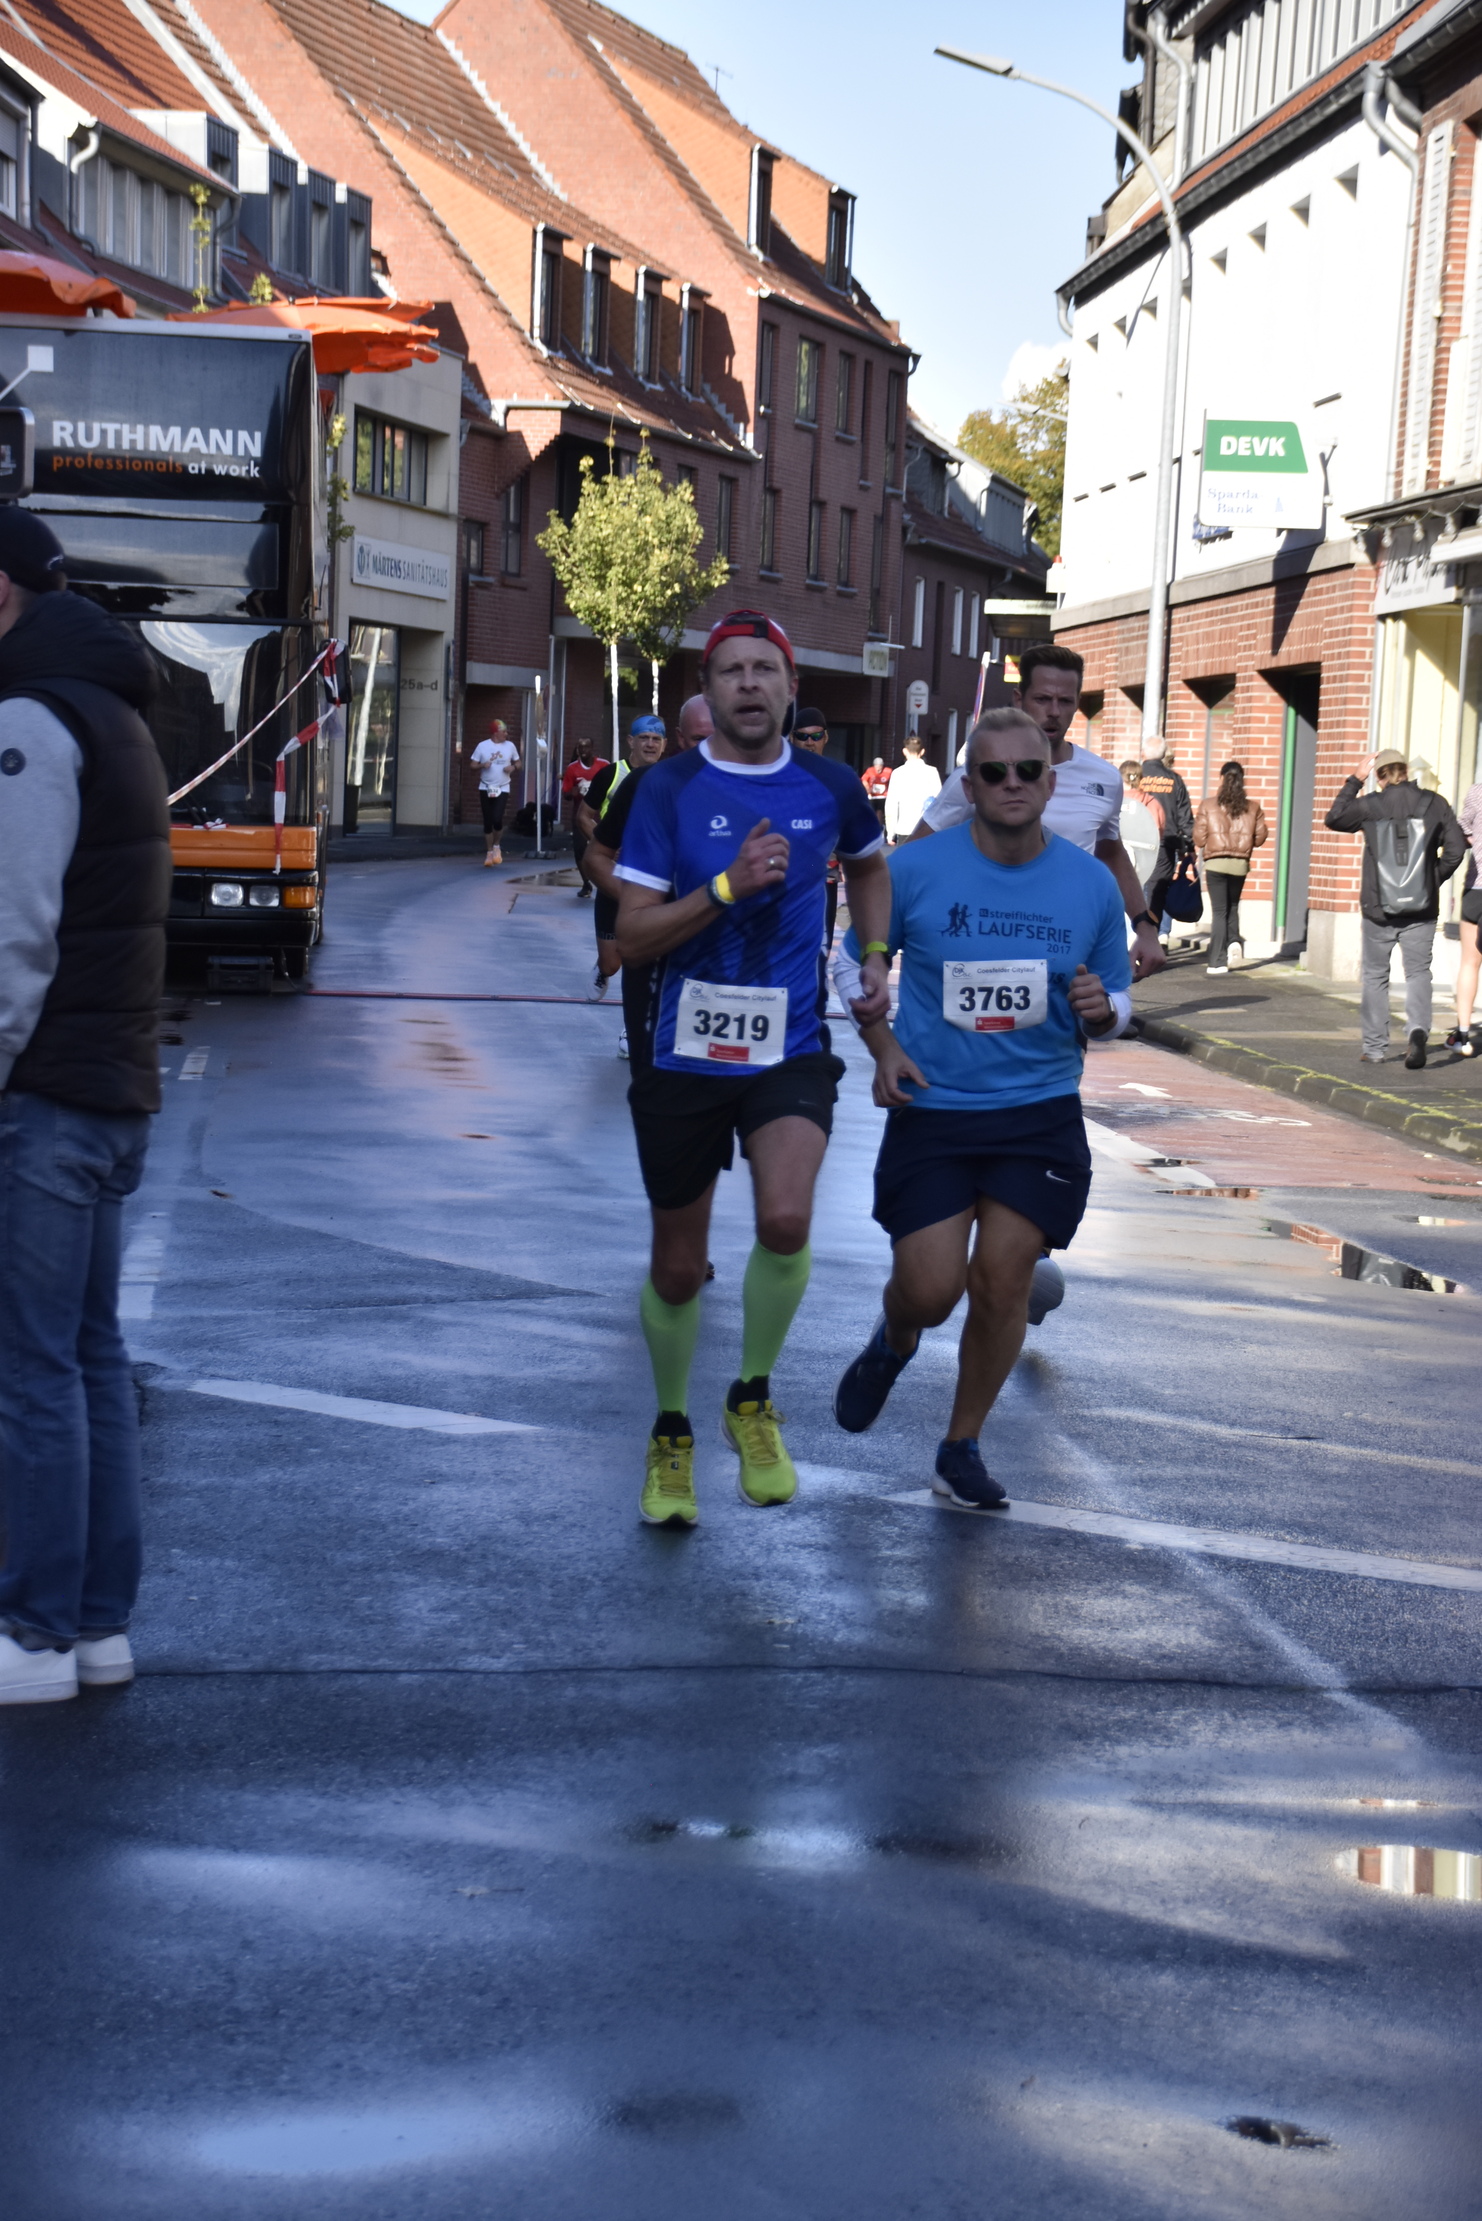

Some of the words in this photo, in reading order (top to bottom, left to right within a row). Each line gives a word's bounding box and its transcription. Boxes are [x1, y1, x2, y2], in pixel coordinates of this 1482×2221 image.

[52, 420, 262, 457] RUTHMANN
[1219, 435, 1287, 457] DEVK
[52, 453, 183, 473] professionals
[188, 461, 206, 475] at
[213, 460, 261, 478] work
[1216, 502, 1254, 514] Bank
[1140, 776, 1174, 785] piridon
[990, 910, 1053, 923] streiflichter
[978, 920, 1072, 944] LAUFSERIE
[1046, 943, 1072, 955] 2017
[976, 966, 1010, 974] Coesfelder
[1011, 965, 1036, 974] Citylauf
[714, 991, 751, 1001] Coesfelder
[751, 994, 777, 1003] Citylauf
[958, 985, 1031, 1013] 3763
[693, 1009, 770, 1042] 3219
